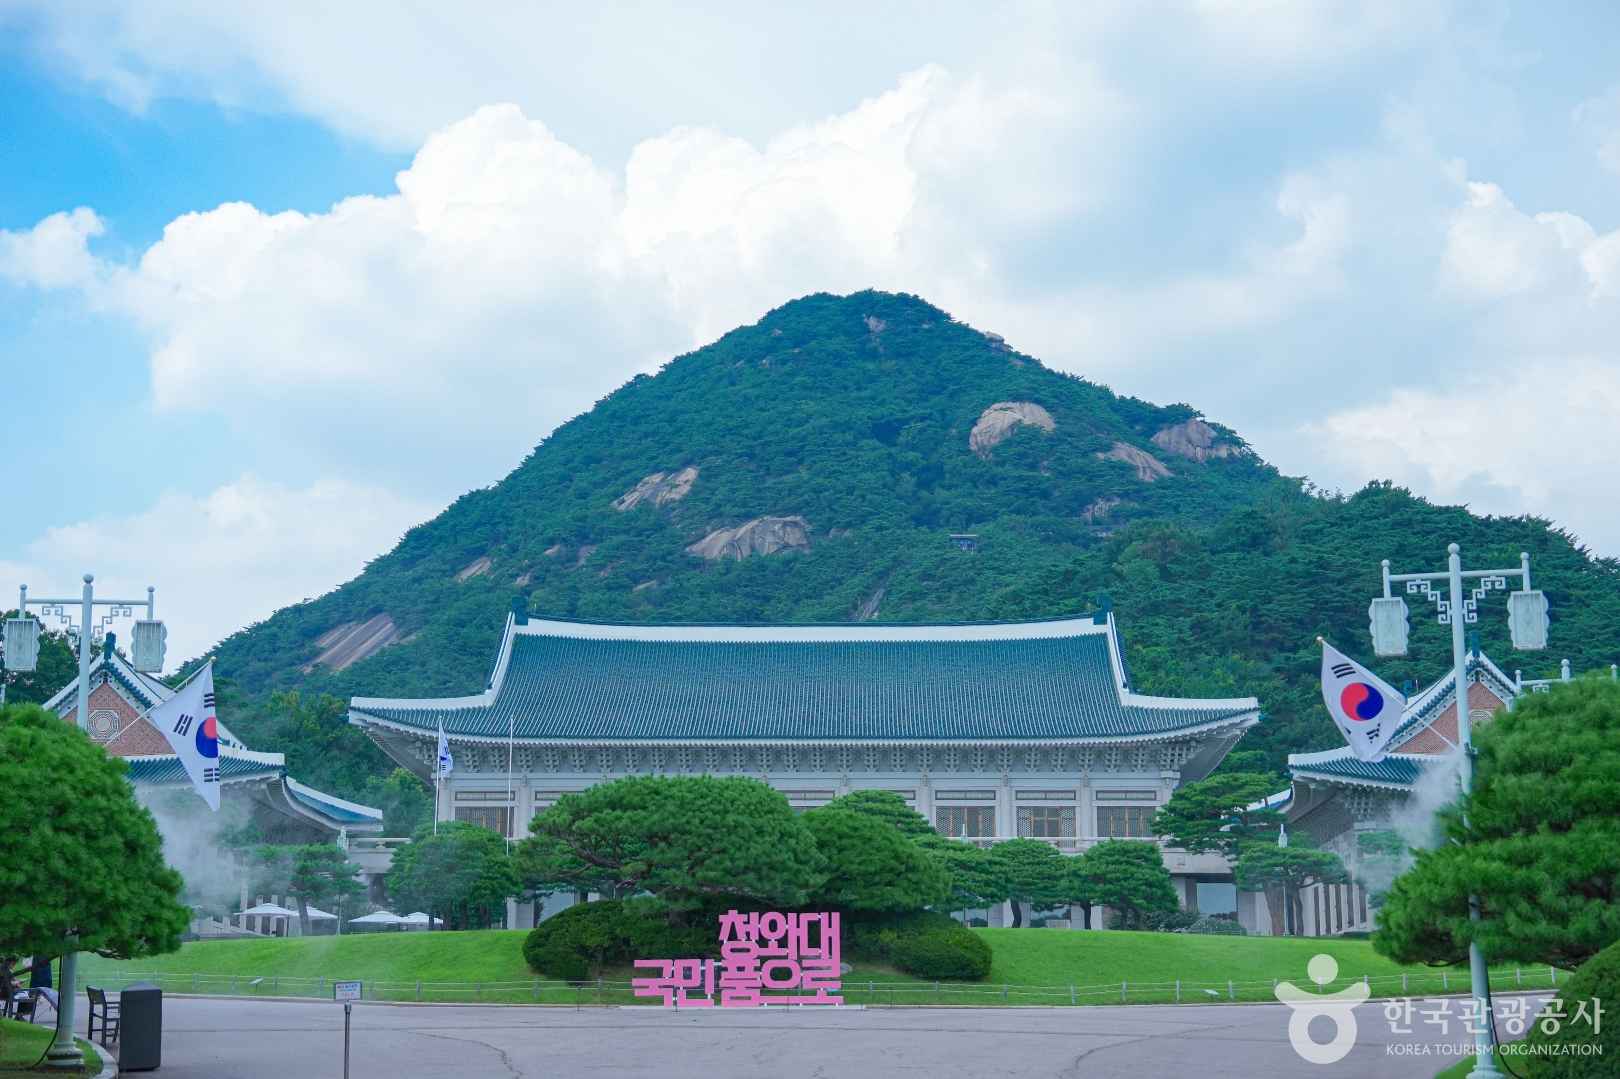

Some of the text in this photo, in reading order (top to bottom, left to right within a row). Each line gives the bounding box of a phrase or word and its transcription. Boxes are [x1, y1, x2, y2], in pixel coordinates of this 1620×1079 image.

[719, 910, 840, 960] 청와대
[632, 959, 843, 1007] 국민 품으로
